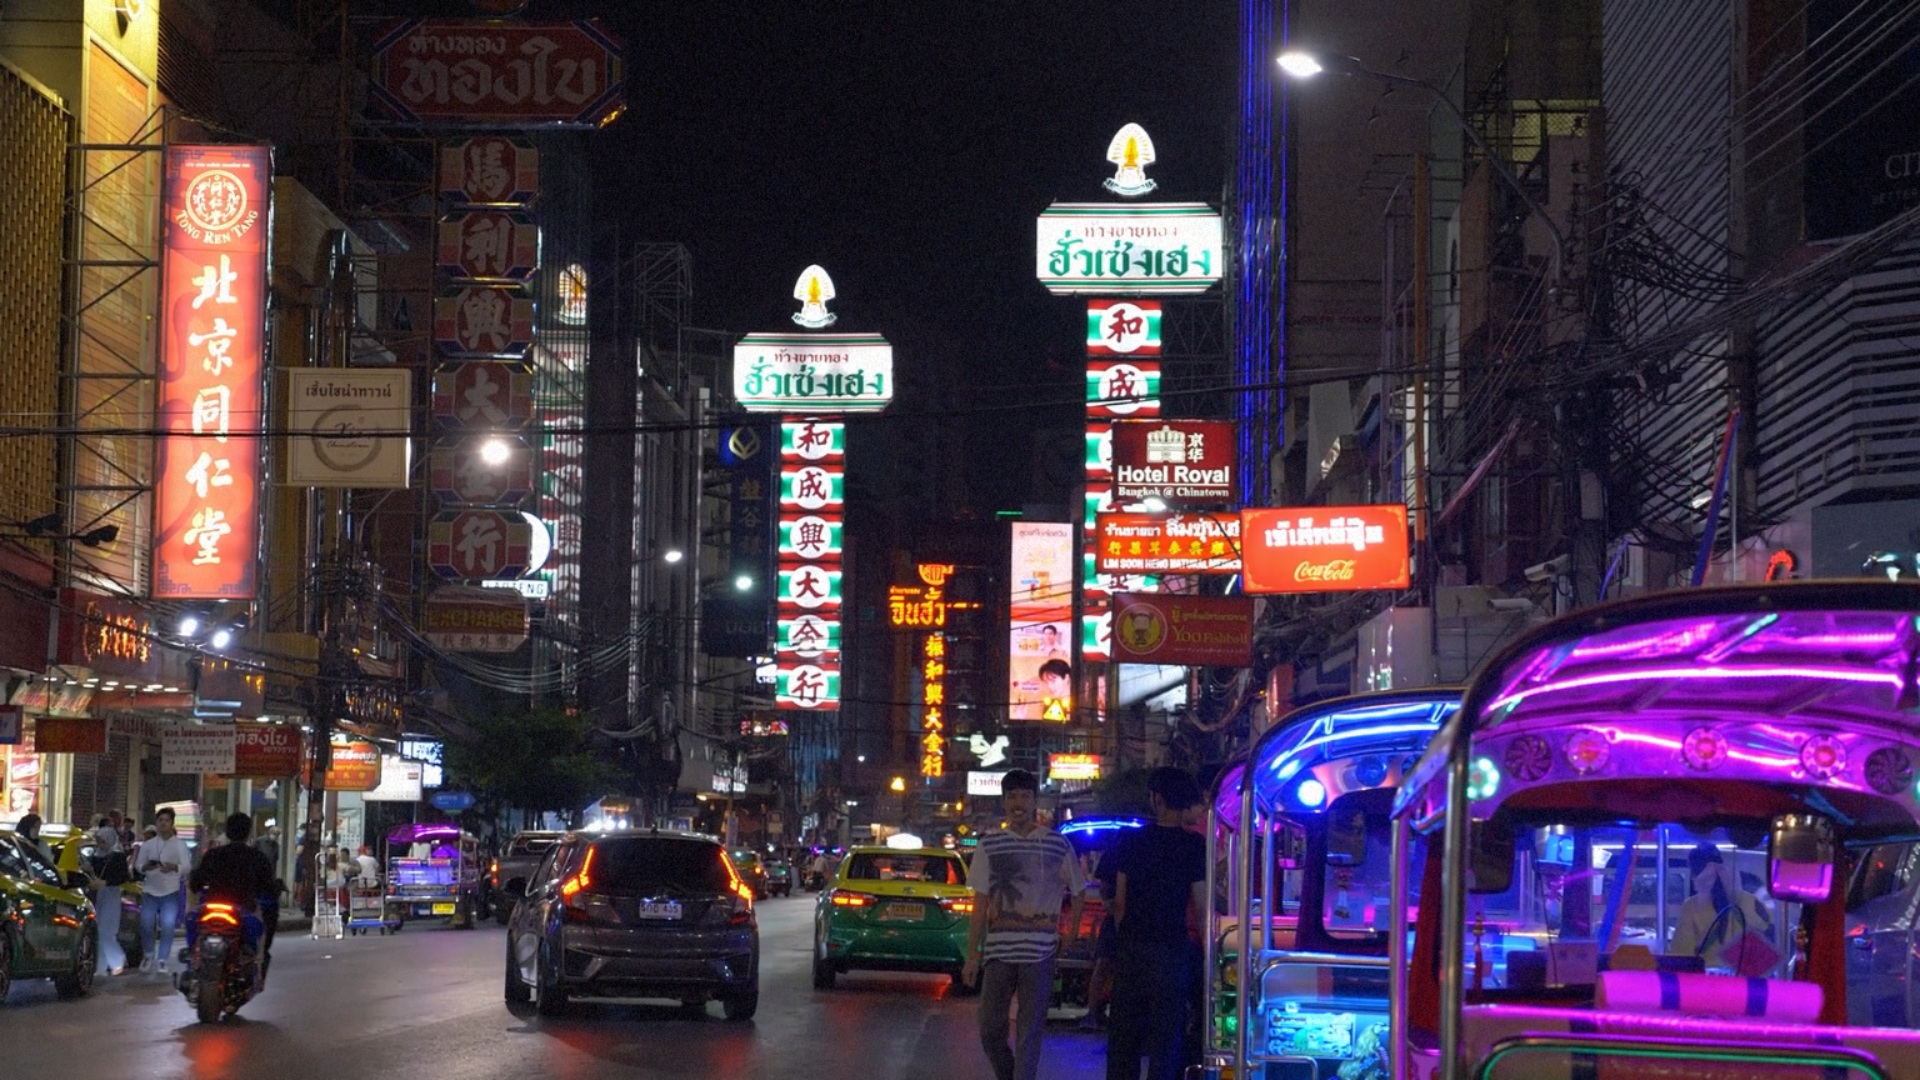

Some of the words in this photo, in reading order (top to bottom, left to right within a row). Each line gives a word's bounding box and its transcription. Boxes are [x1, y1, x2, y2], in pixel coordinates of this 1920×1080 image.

[400, 36, 597, 104] ทองใบ
[175, 209, 201, 239] TONG
[203, 230, 231, 244] REN
[231, 209, 259, 238] TANG
[183, 253, 238, 566] 北京同仁堂
[1118, 465, 1168, 482] Hotel
[1174, 465, 1230, 484] Royal
[1118, 486, 1161, 498] Bangkok
[1163, 487, 1174, 497] @
[1176, 487, 1229, 497] Chinatown
[792, 423, 830, 703] 和成興大金行
[1294, 559, 1357, 582] Coca-Cola
